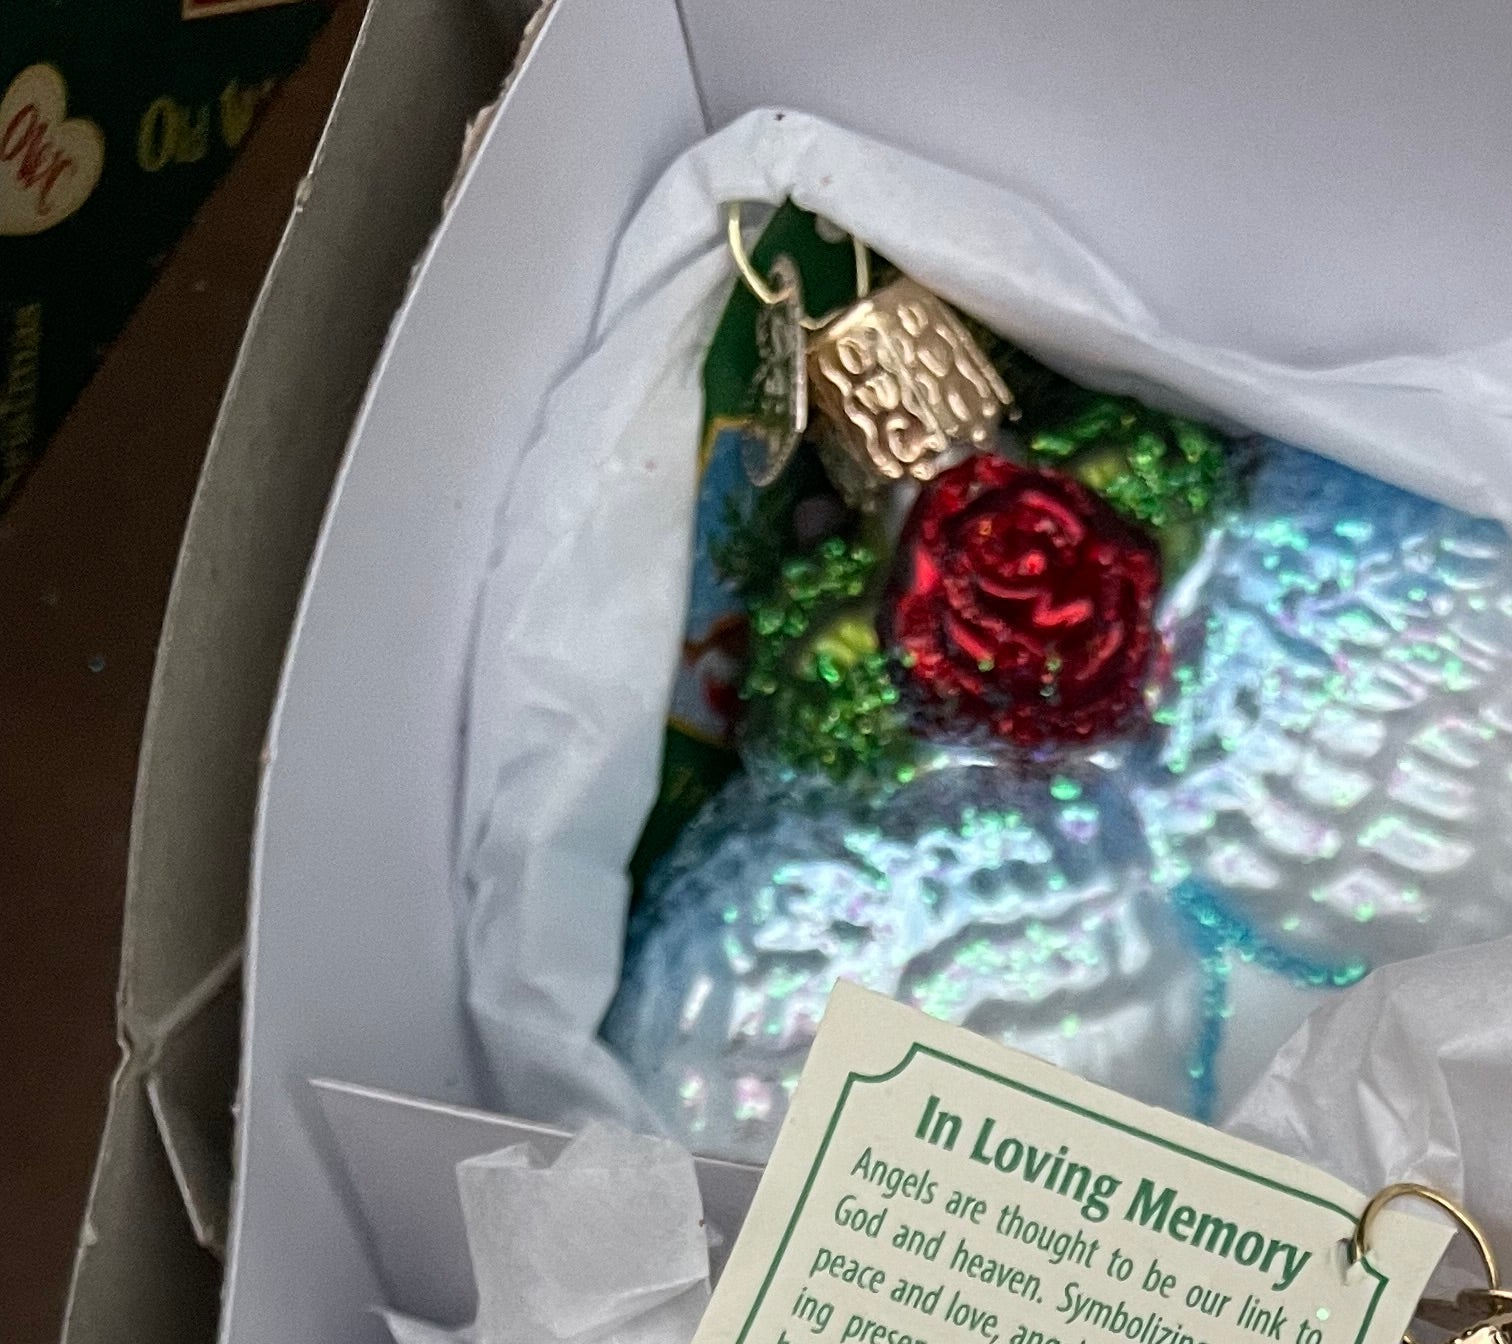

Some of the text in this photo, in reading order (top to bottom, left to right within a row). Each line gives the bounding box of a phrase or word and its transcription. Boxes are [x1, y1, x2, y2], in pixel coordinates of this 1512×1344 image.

[849, 1146, 939, 1205] Angels
[944, 1190, 988, 1225] are
[995, 1204, 1101, 1269] thought
[1106, 1247, 1134, 1282] to
[1141, 1258, 1177, 1299] be
[1185, 1284, 1233, 1319] our
[1236, 1294, 1289, 1341] link
[914, 1093, 1313, 1292] In Loving Memory
[808, 1247, 886, 1294] peace
[889, 1278, 946, 1316] and
[834, 1194, 889, 1239] God
[891, 1223, 947, 1262] and
[948, 1236, 1043, 1304] heaven.
[790, 1286, 835, 1335] ing
